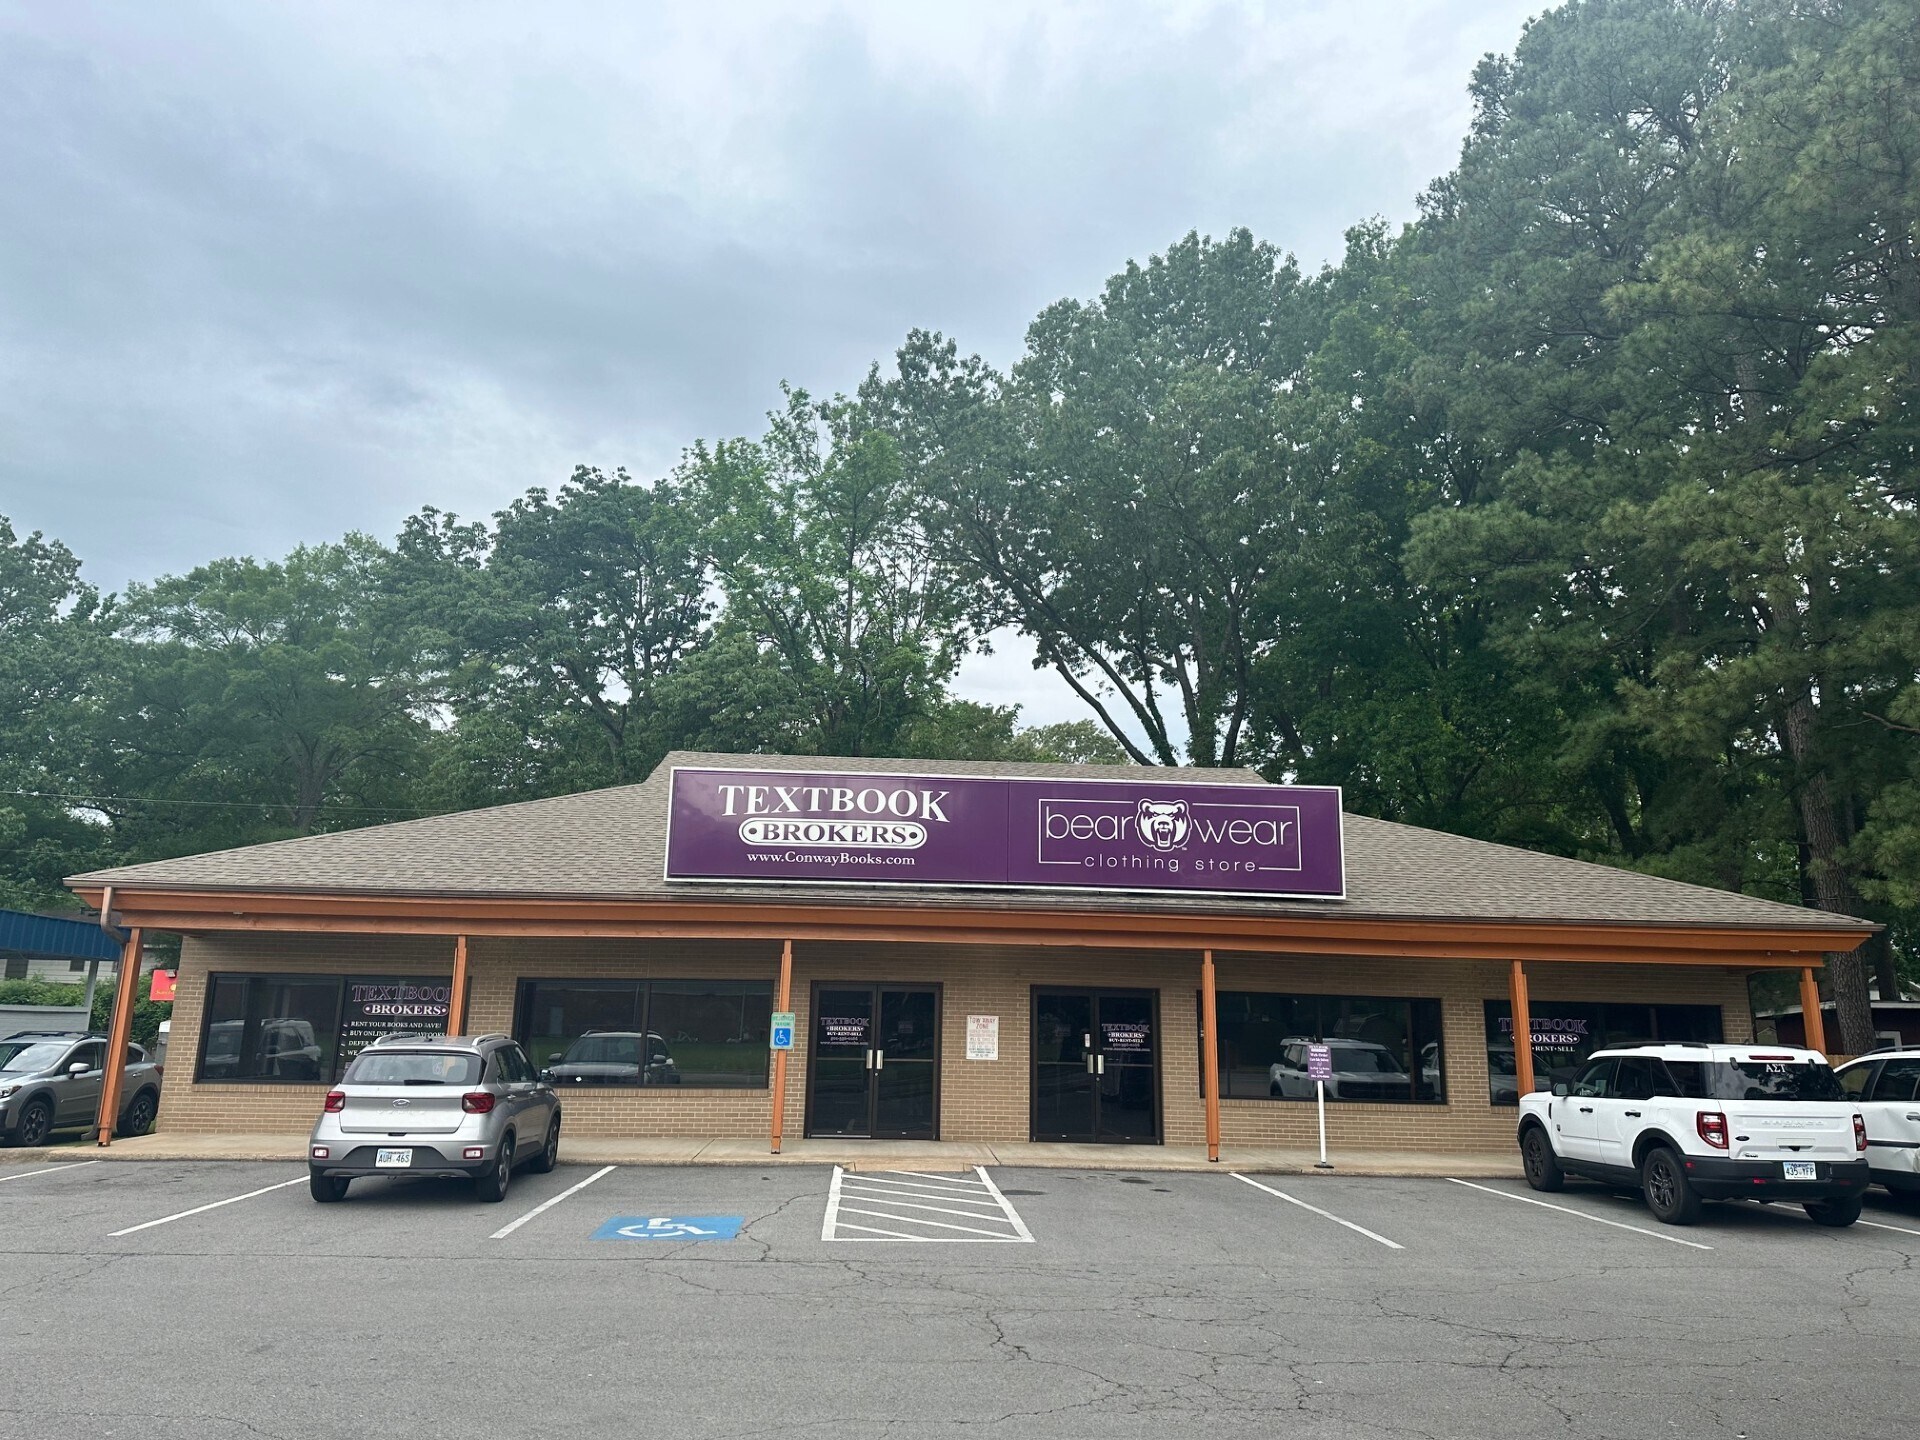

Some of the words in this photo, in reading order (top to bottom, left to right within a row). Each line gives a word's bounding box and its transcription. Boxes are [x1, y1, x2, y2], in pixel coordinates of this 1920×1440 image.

[718, 785, 950, 823] TEXTBOOK
[1045, 805, 1134, 841] bear
[1194, 818, 1293, 845] wear
[762, 823, 907, 844] BROKERS
[746, 851, 916, 867] www.ConwayBooks.com
[1084, 853, 1180, 872] clothing
[1194, 857, 1256, 872] store
[371, 1004, 441, 1015] BROKERS
[820, 1017, 870, 1027] TEXTBOOK
[1102, 1024, 1150, 1033] TEXTBOOK
[1498, 1017, 1589, 1034] TTBOOK
[1529, 1034, 1573, 1043] OKERS
[378, 1154, 392, 1163] AUH
[1785, 1167, 1798, 1176] 435
[1802, 1167, 1815, 1176] YFP
